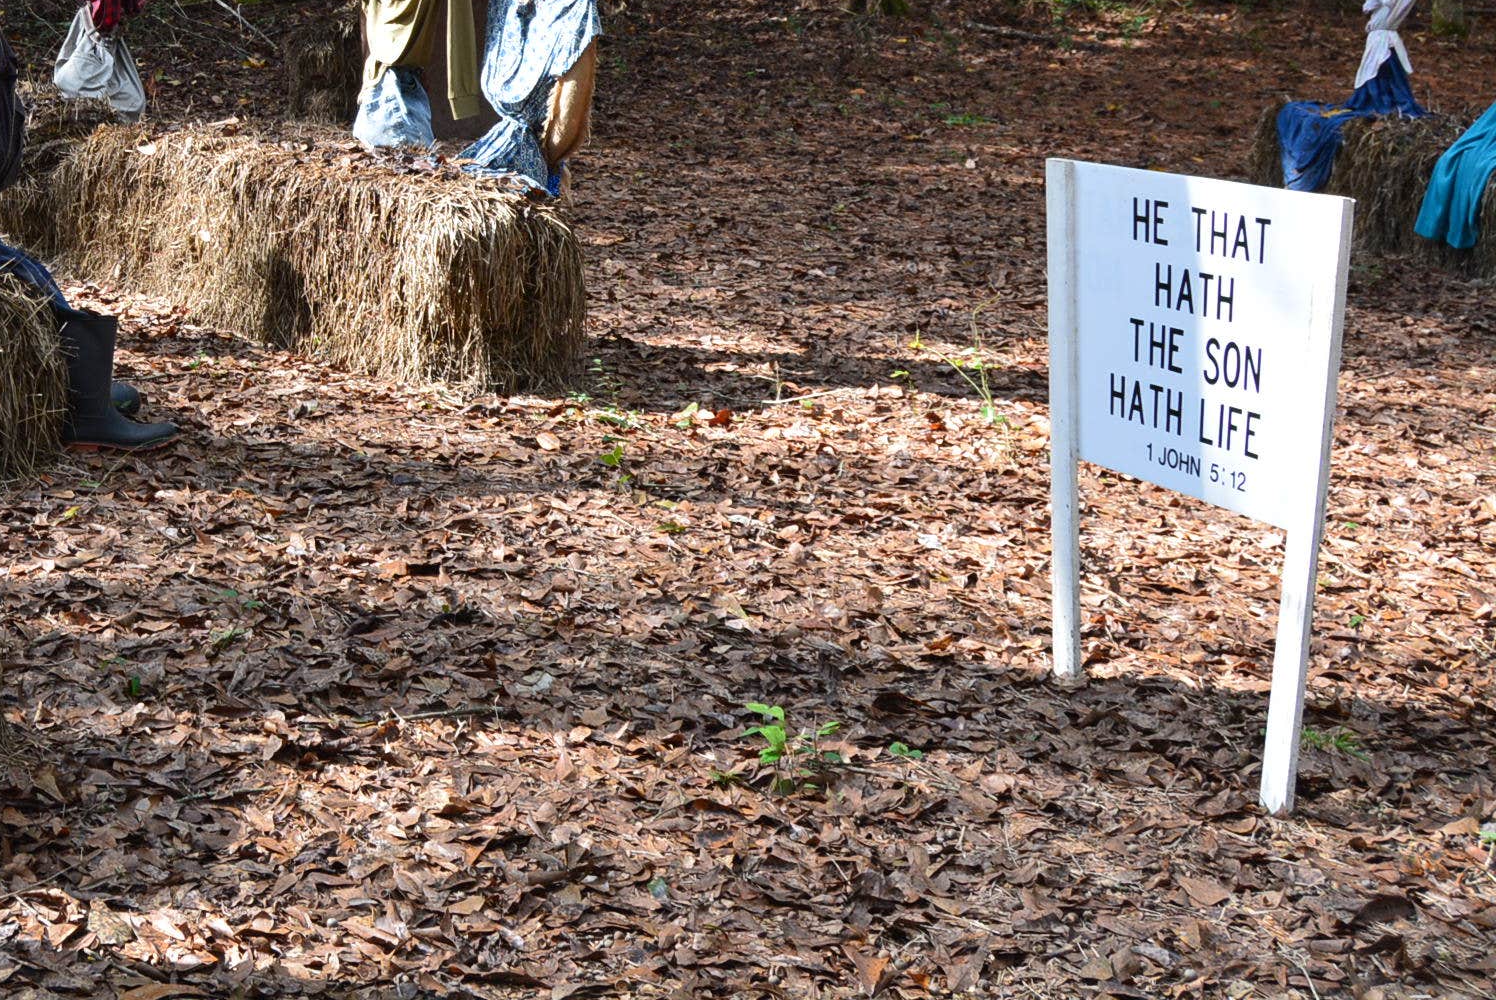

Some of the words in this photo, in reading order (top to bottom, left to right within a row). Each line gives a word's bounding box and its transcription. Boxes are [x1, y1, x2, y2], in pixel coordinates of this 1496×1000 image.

[1133, 197, 1169, 246] HE
[1191, 206, 1272, 264] THAT
[1154, 262, 1235, 323] HATH
[1129, 317, 1185, 374] THE
[1203, 337, 1262, 394] SON
[1110, 372, 1183, 436] HATH
[1199, 398, 1262, 460] LIFE
[1146, 443, 1153, 462] 1
[1158, 447, 1201, 478] JOHN
[1210, 463, 1247, 493] 5:12
